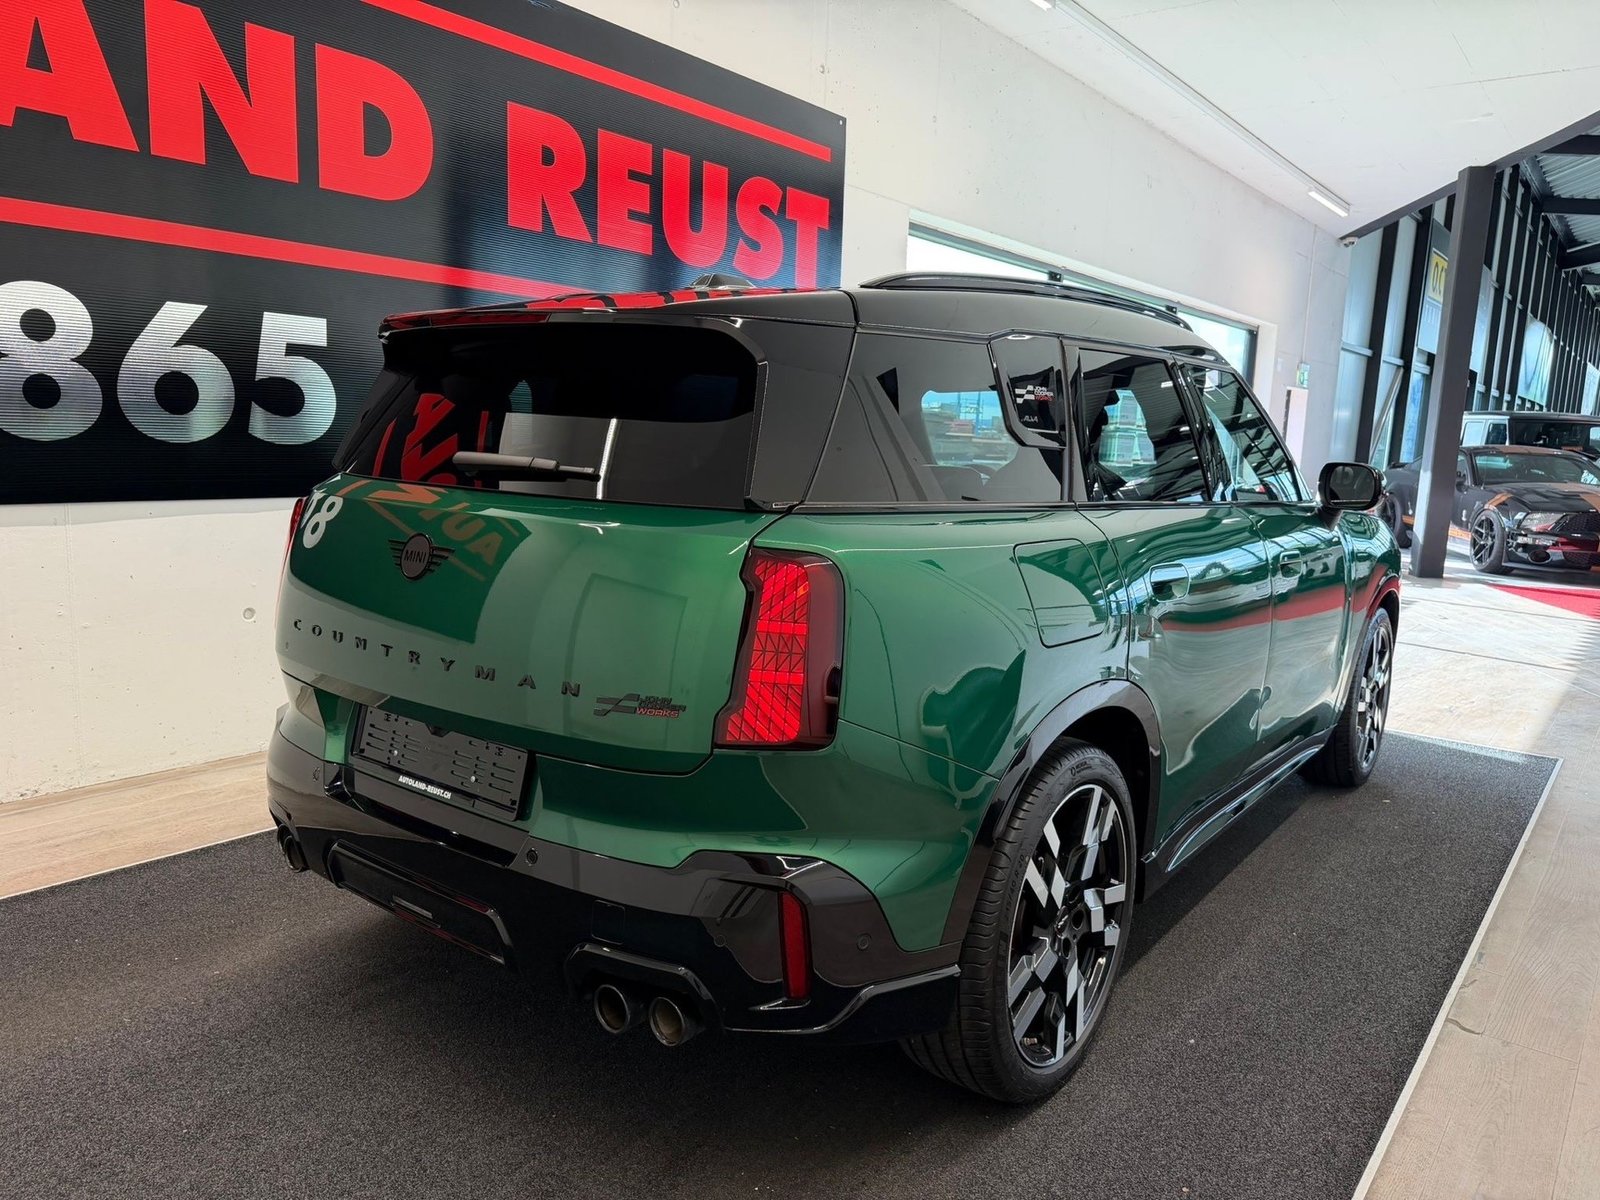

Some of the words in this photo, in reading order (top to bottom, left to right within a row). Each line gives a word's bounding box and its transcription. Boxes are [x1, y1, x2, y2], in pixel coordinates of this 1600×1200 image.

[507, 102, 830, 288] REUST
[0, 280, 337, 445] 865
[404, 550, 427, 563] MINI
[293, 619, 580, 697] COUNTRYMAN
[636, 707, 680, 718] WORKS
[398, 775, 452, 799] AUTOLAND-REUST.CH
